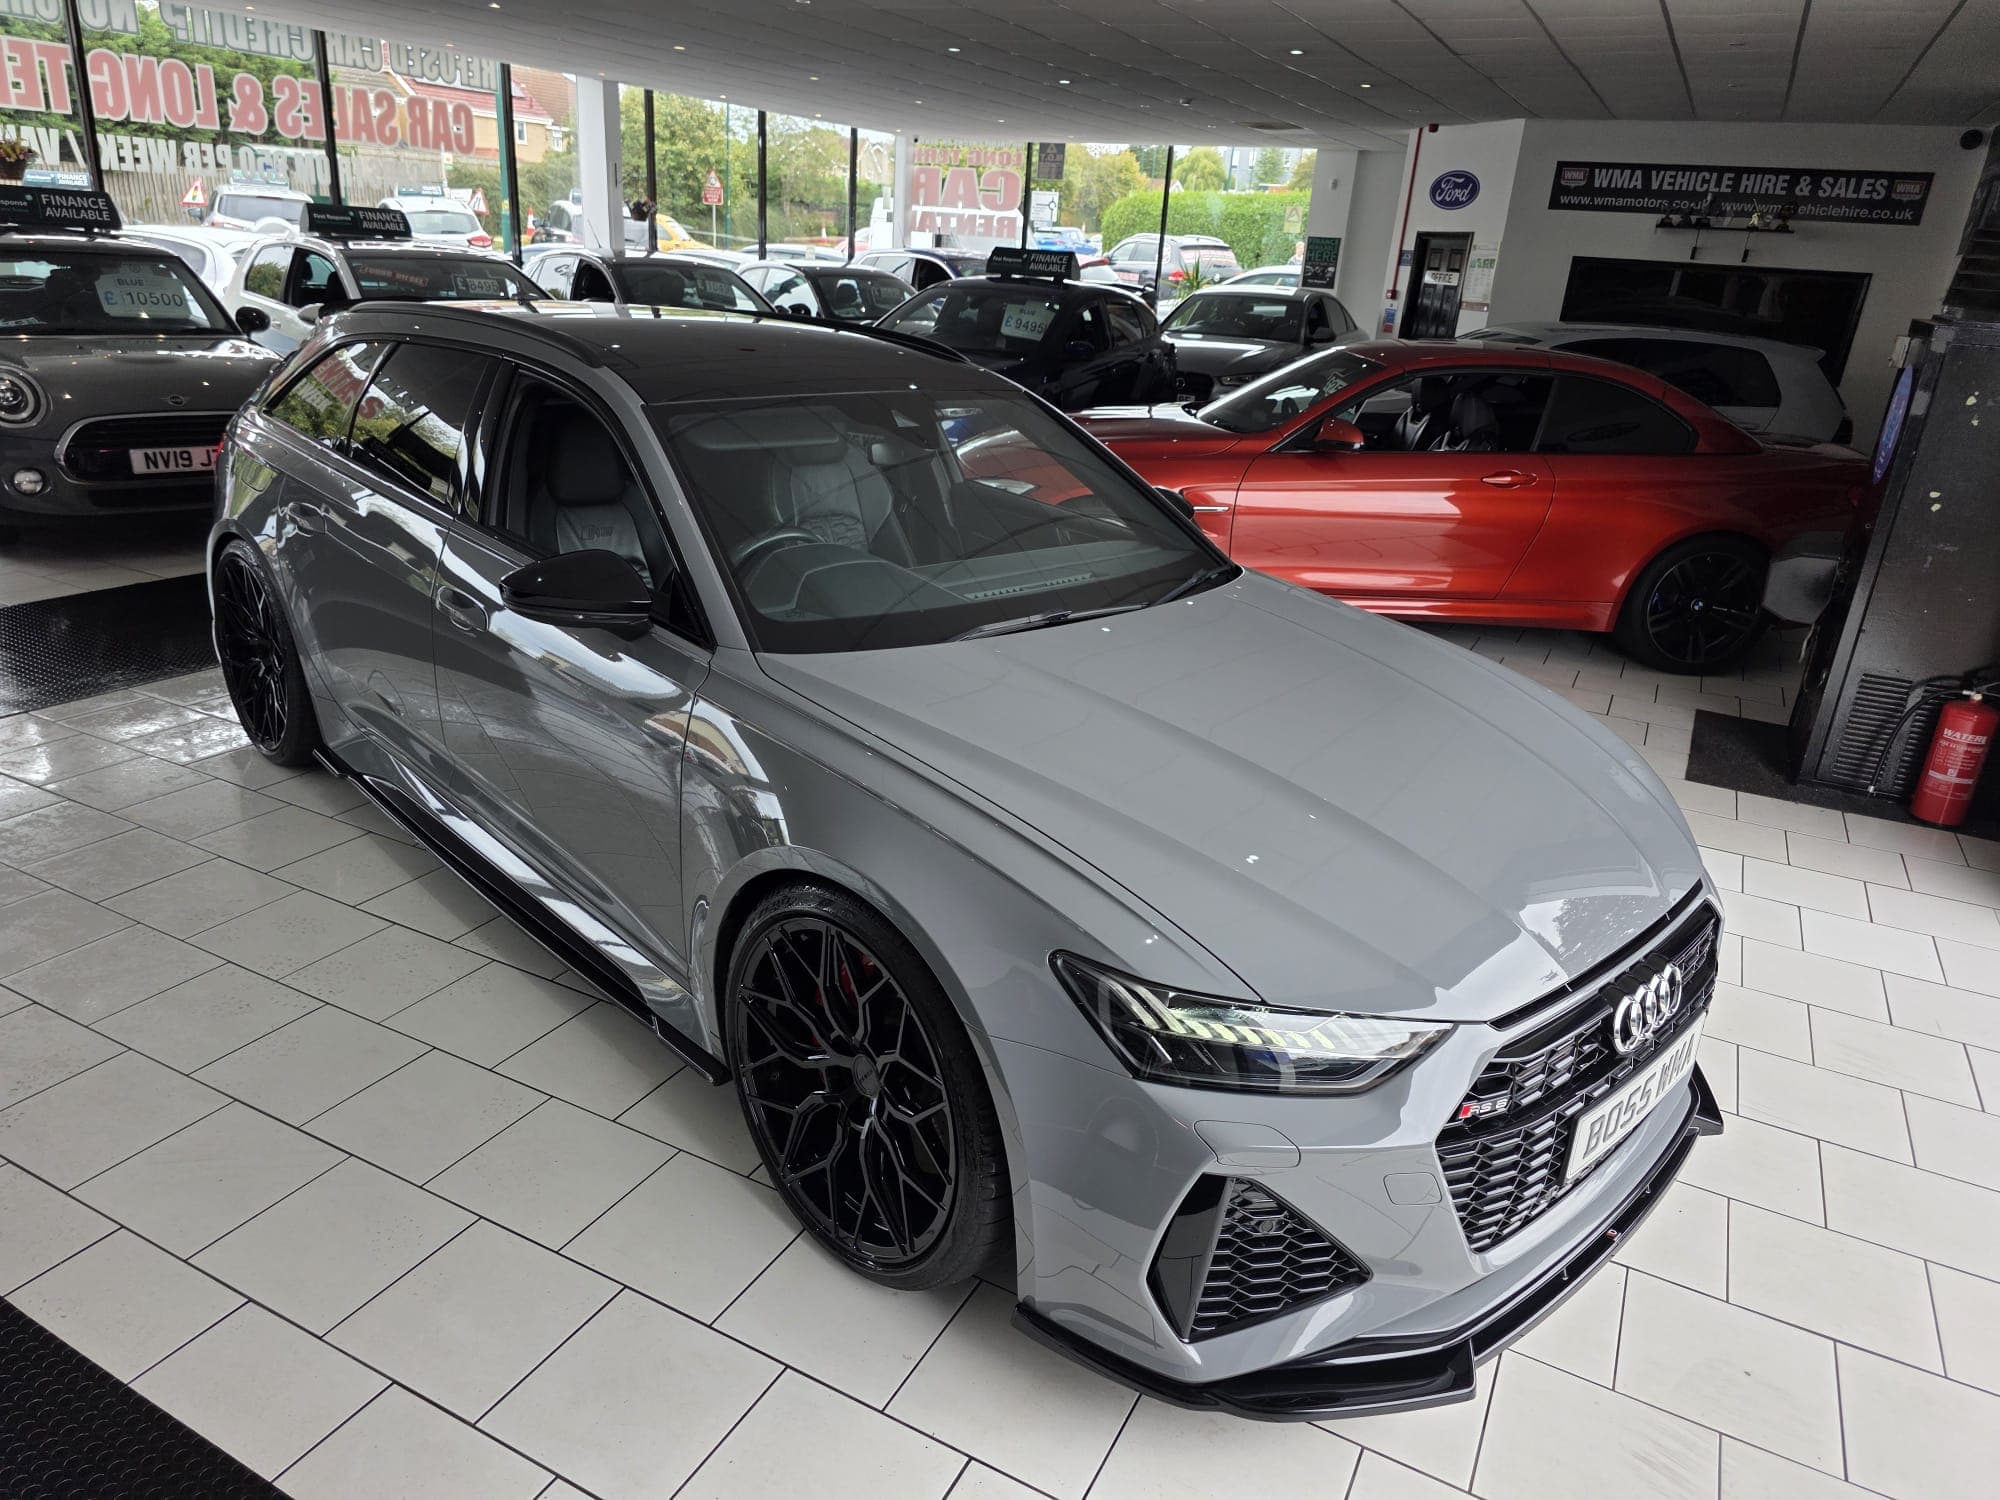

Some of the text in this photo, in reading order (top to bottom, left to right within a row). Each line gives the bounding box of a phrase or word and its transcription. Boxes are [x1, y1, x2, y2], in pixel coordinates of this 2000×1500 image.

[1435, 175, 1474, 202] Ford
[1594, 168, 1889, 200] WMA VEHICLE HIRE & SALES
[41, 194, 110, 211] FINANCE
[1721, 201, 1913, 220] wwwwmehiclehire.co.uk
[45, 207, 111, 221] AVAILABLE
[359, 210, 402, 222] FINANCE
[362, 220, 406, 232] AVAILABLE
[1030, 253, 1069, 264] FINANCE
[1029, 262, 1067, 273] AVAILABLE
[103, 291, 184, 308] £ 10500
[1004, 315, 1014, 328] £
[143, 450, 194, 470] NV19
[1656, 1033, 1696, 1099] WMA
